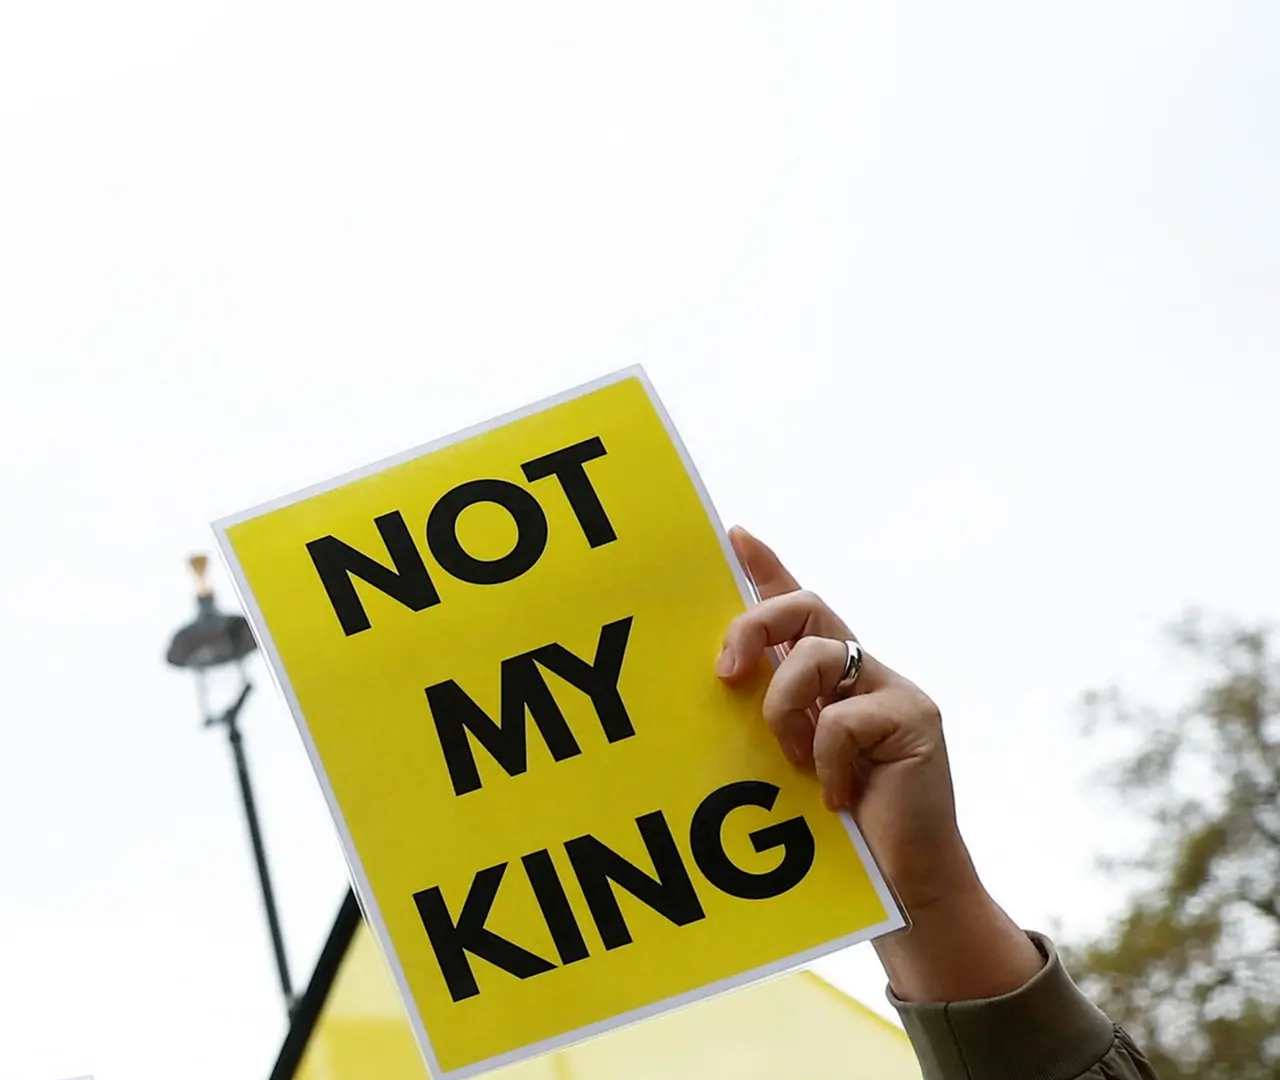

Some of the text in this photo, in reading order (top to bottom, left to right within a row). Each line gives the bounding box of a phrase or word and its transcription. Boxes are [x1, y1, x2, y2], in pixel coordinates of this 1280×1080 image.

[305, 435, 618, 637] NOT
[424, 615, 637, 797] MY
[412, 780, 816, 1003] KING
